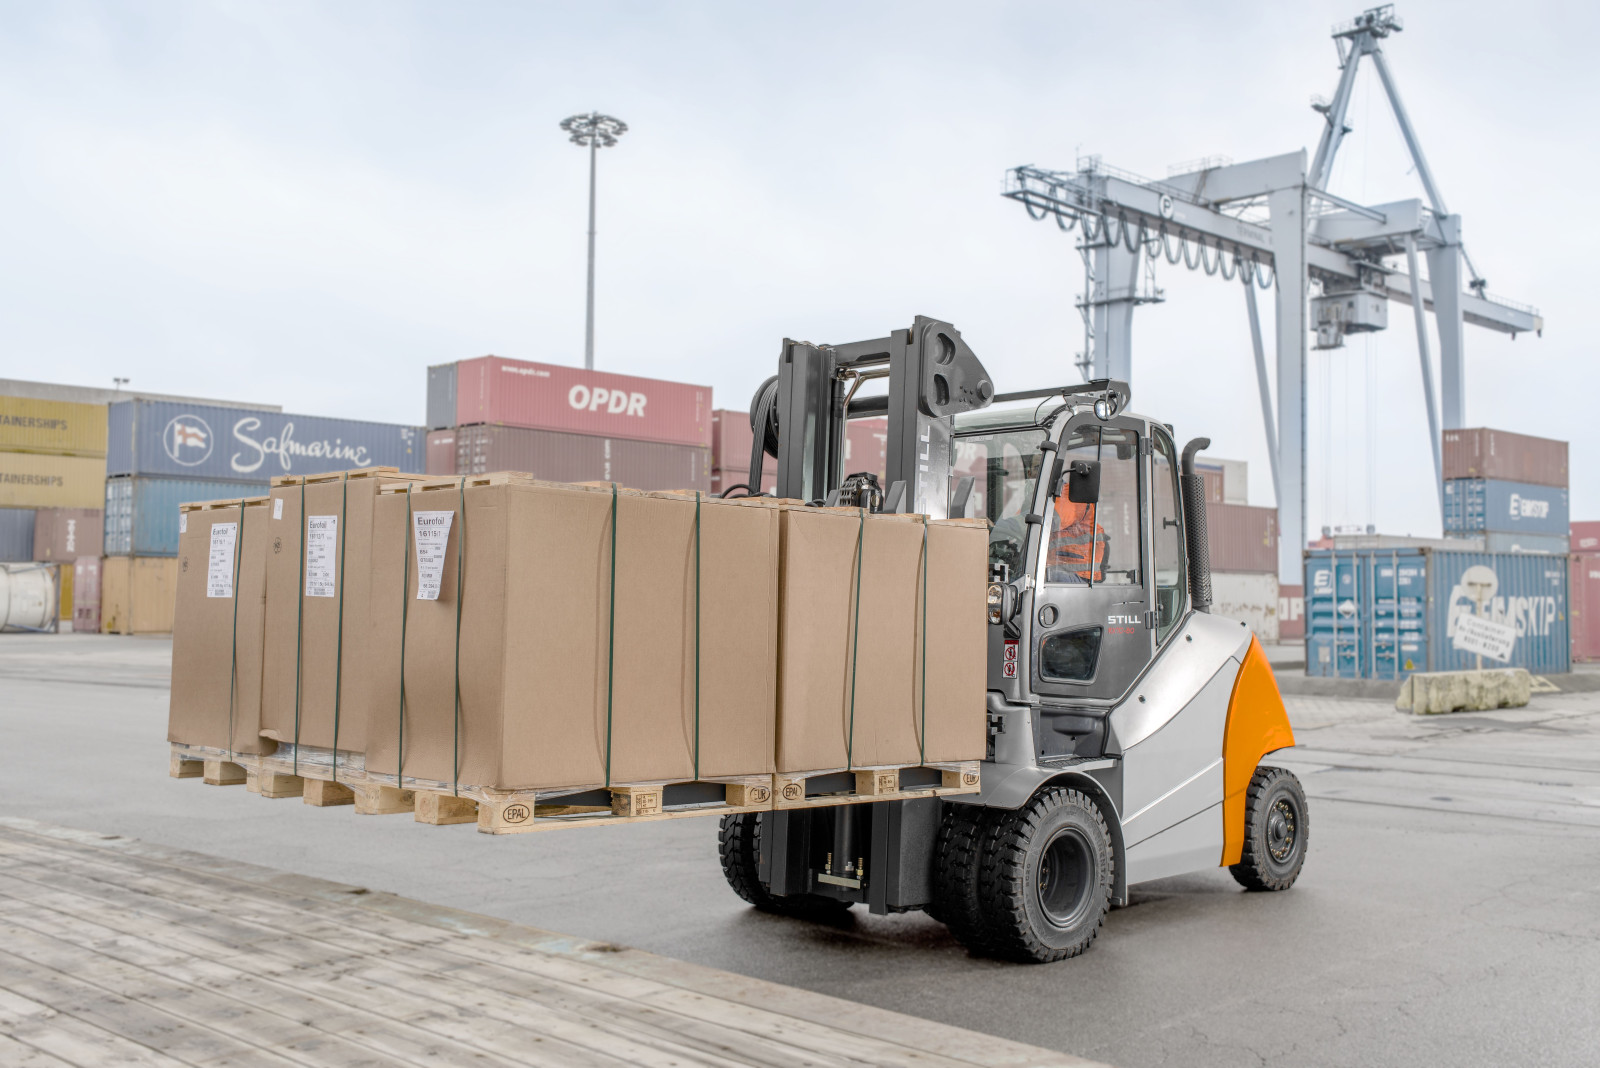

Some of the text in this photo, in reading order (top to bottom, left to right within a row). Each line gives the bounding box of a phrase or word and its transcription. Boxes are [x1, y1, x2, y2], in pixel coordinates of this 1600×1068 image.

[568, 384, 648, 417] OPDR
[231, 417, 371, 472] Safmarine
[417, 517, 444, 525] Eurofoil
[1107, 615, 1142, 624] STILL
[785, 786, 798, 797] EPAL
[507, 808, 526, 820] EPAL
